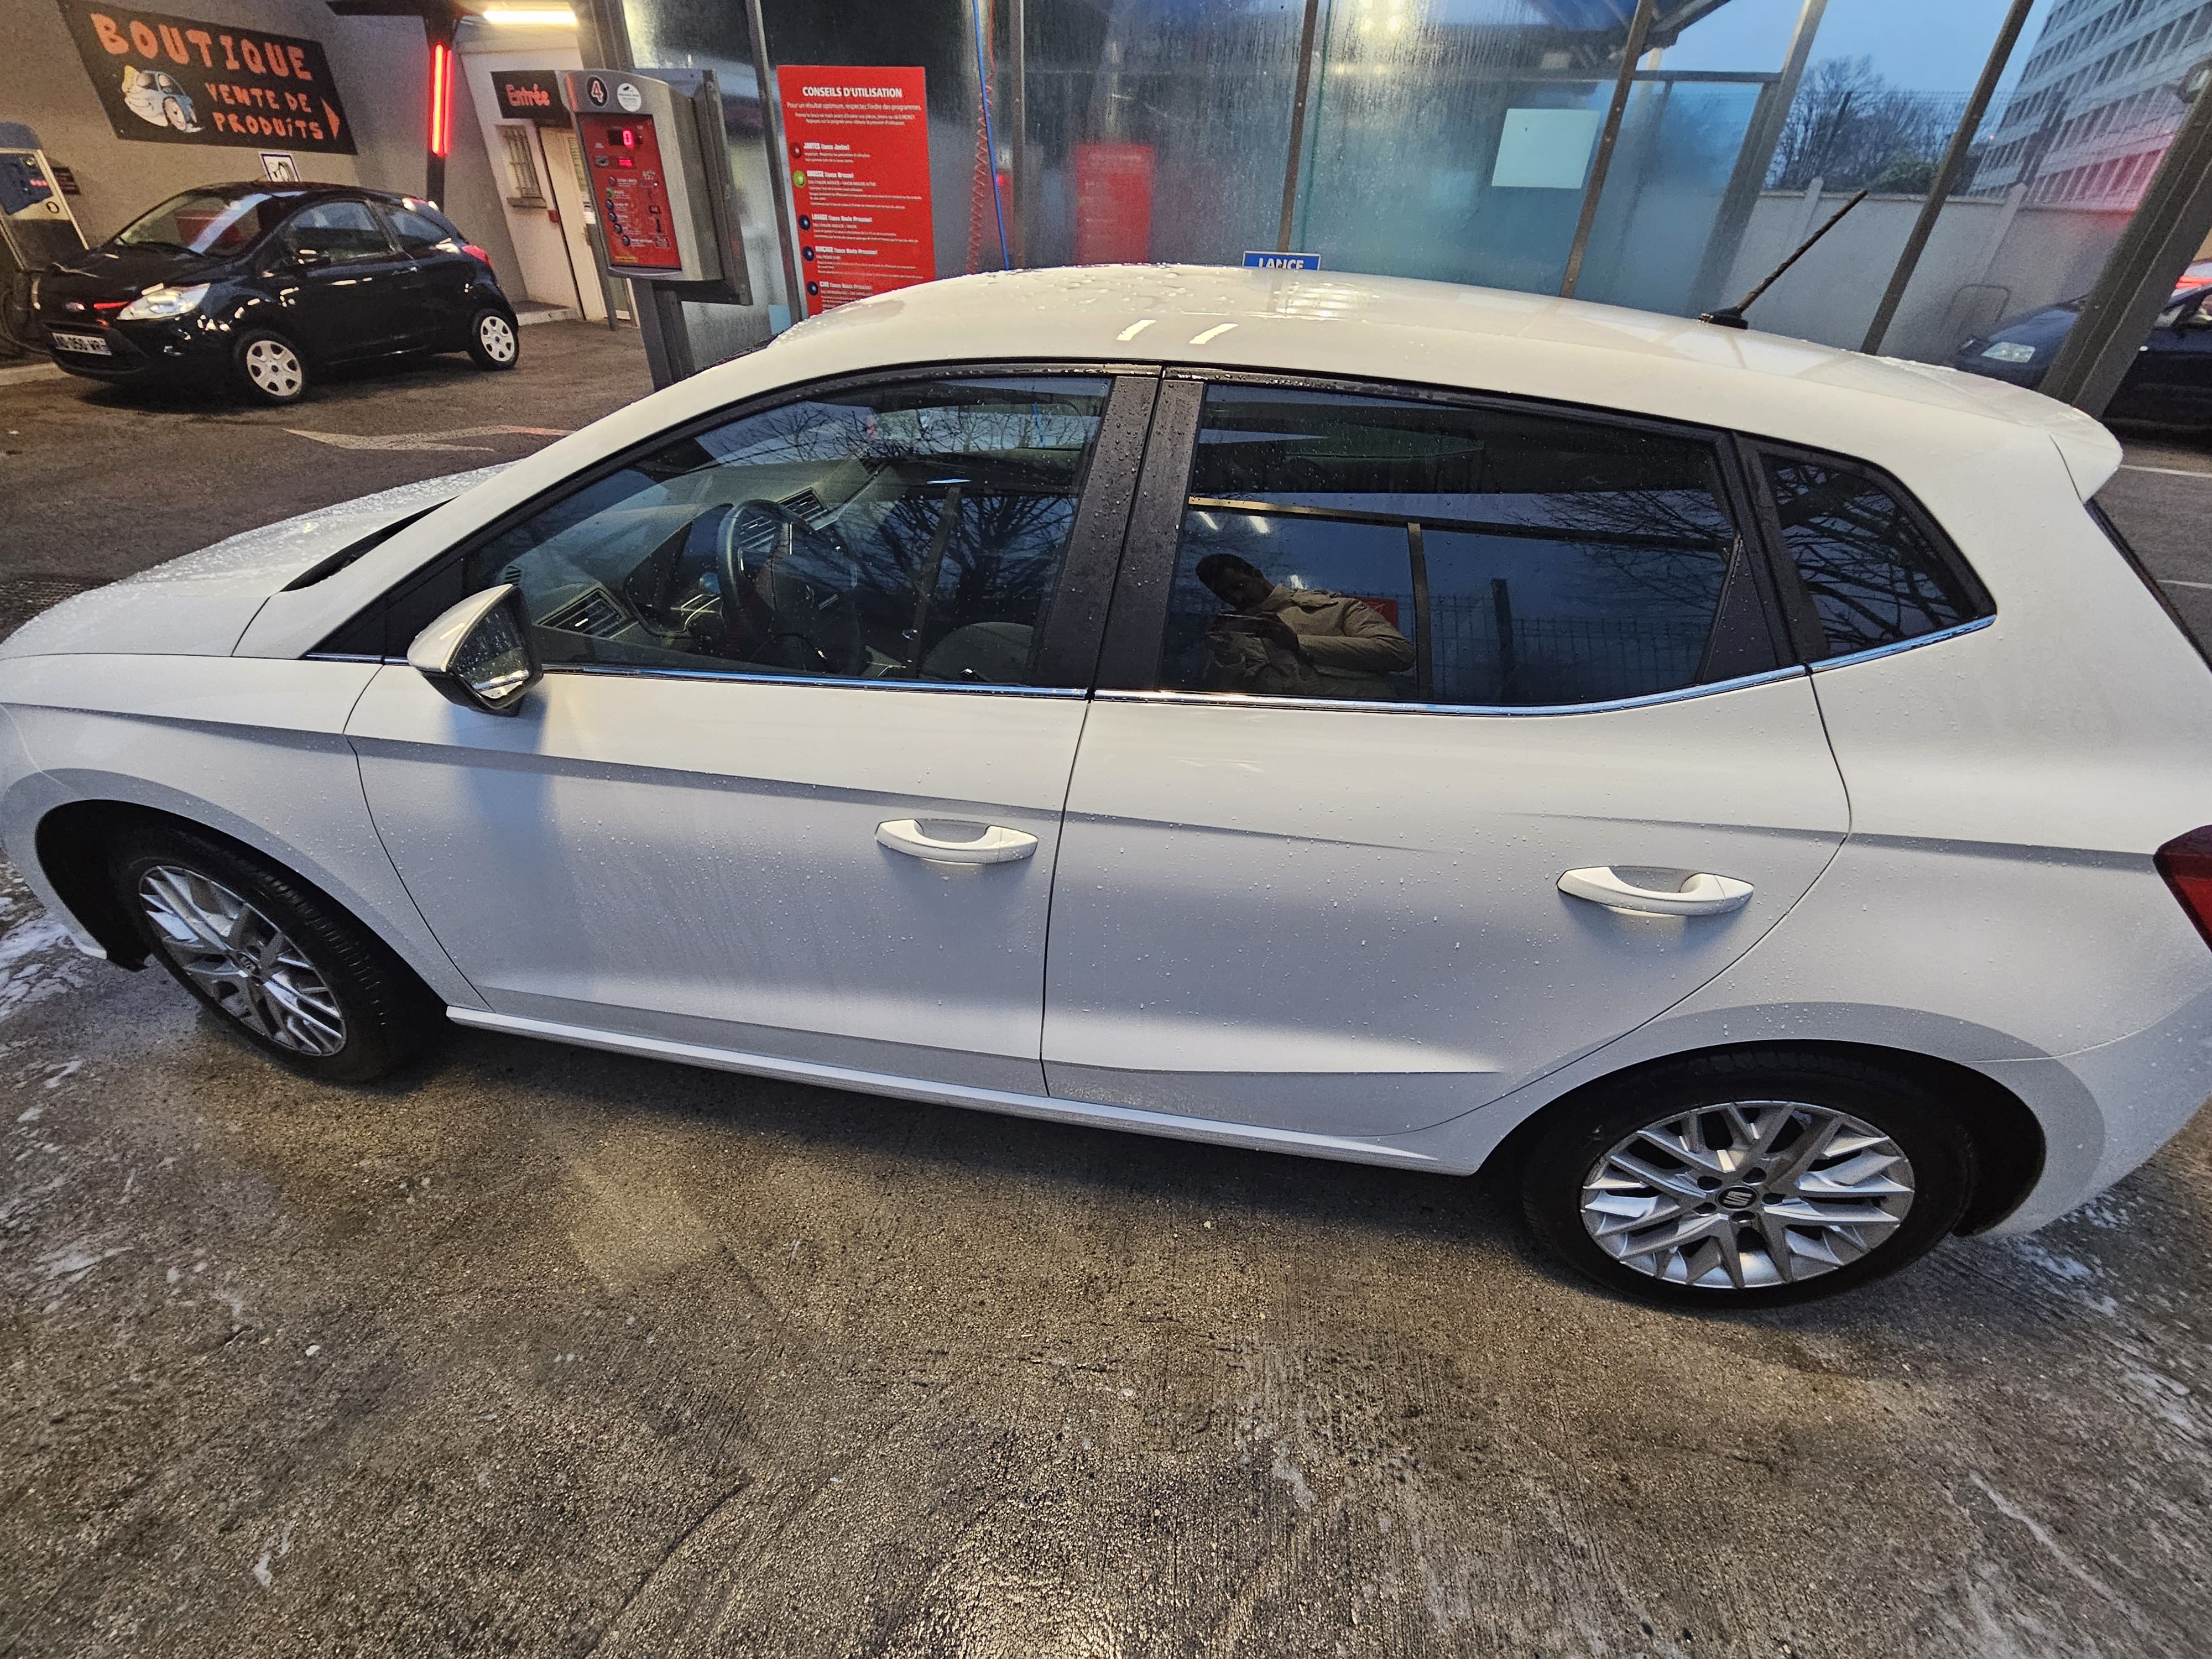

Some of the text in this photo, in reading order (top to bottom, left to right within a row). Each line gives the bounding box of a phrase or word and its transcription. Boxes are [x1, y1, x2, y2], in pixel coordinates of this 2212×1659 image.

[90, 13, 313, 81] BOUTIQUE
[205, 82, 312, 112] VENTE DE
[505, 83, 550, 106] Entrée
[591, 80, 603, 103] 4
[802, 86, 902, 98] CONSEILS D'UTILISATION
[1258, 258, 1304, 270] LANCE
